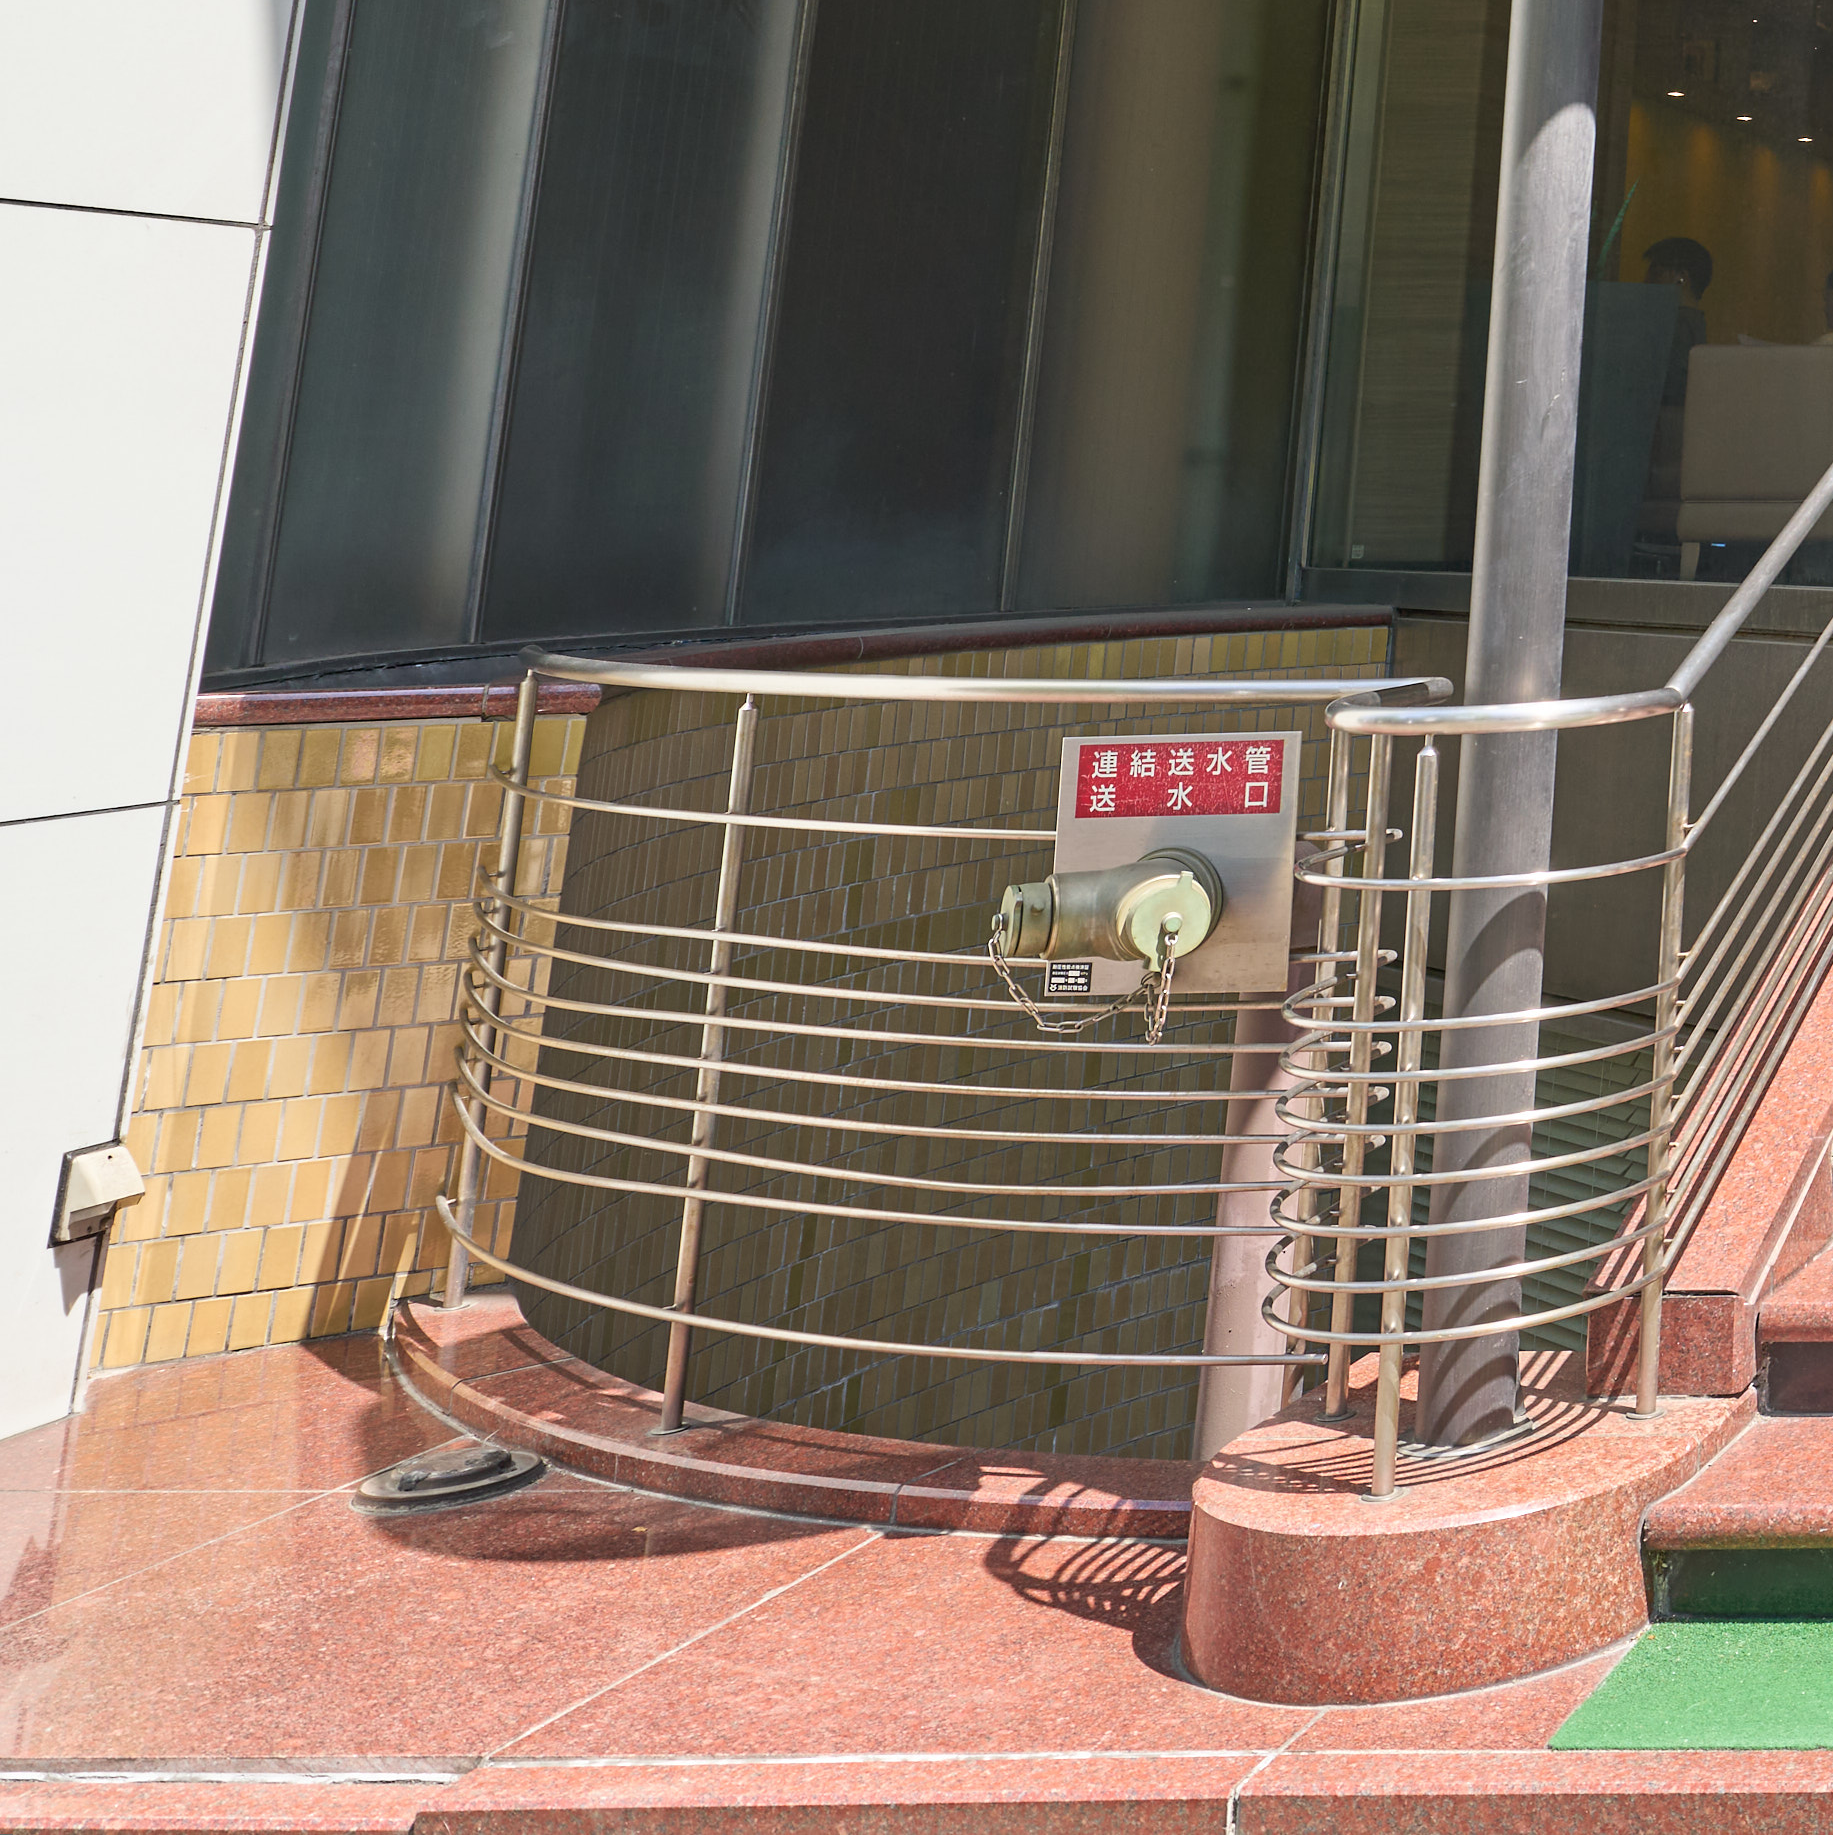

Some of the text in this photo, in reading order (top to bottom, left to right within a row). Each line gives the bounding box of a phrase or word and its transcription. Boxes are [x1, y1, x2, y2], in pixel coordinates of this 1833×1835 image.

[1091, 745, 1272, 781] 連結送水管
